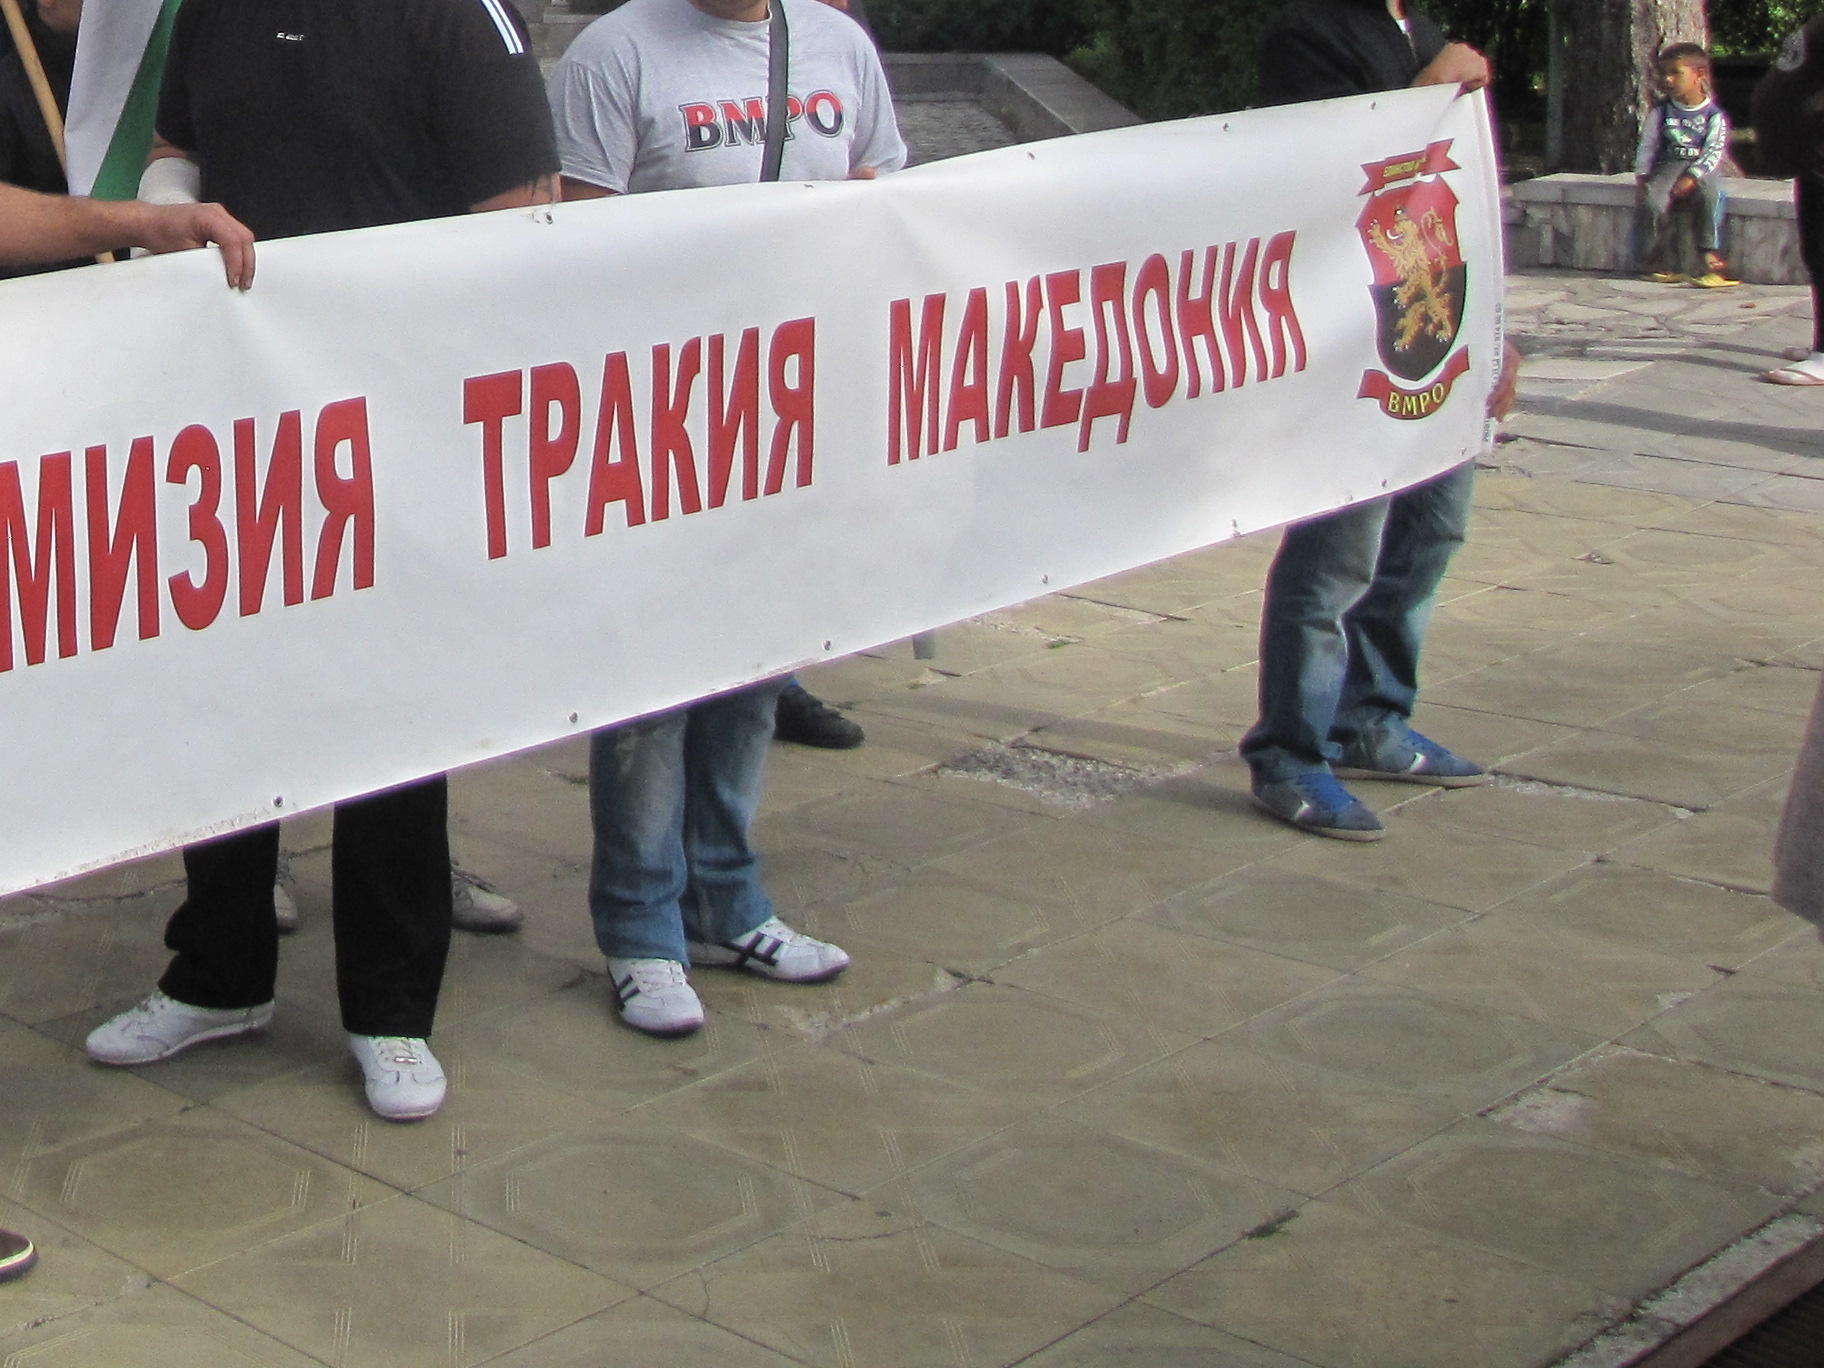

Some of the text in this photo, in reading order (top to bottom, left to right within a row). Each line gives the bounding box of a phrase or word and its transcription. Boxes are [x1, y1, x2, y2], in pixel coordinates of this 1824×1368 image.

[679, 89, 845, 152] ВМРО
[463, 316, 816, 560] ТРАКИЯ
[886, 230, 1306, 466] МАКЕДОНИЯ
[1387, 382, 1445, 417] ВМРО
